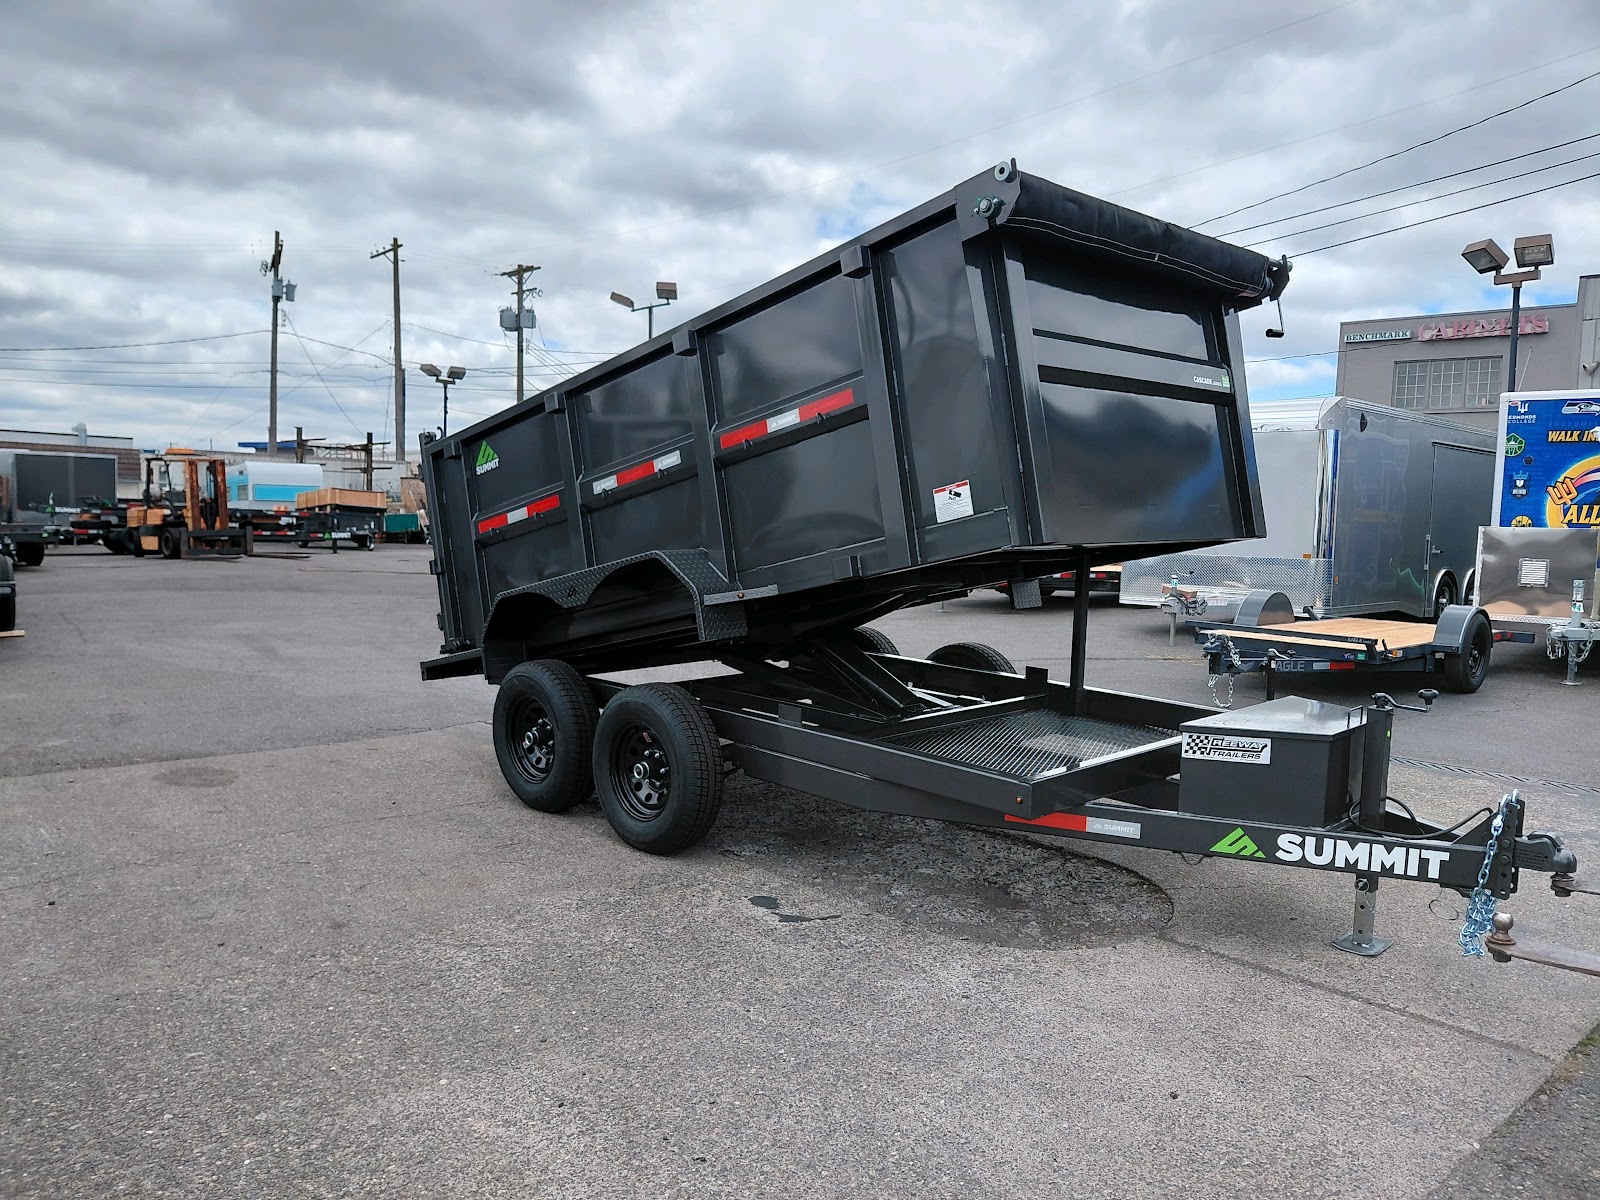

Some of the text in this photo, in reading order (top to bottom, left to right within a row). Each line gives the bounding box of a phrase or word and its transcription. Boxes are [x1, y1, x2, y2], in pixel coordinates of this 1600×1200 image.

[1346, 330, 1409, 341] BENCHMARK
[1193, 376, 1212, 385] CASCADE
[1547, 430, 1581, 442] WALK
[476, 458, 500, 476] SUMMIT
[1274, 660, 1306, 673] AGLE
[1211, 750, 1262, 760] TRAILERS
[1103, 823, 1135, 834] SUMMIT
[1275, 833, 1450, 879] SUMMIT
